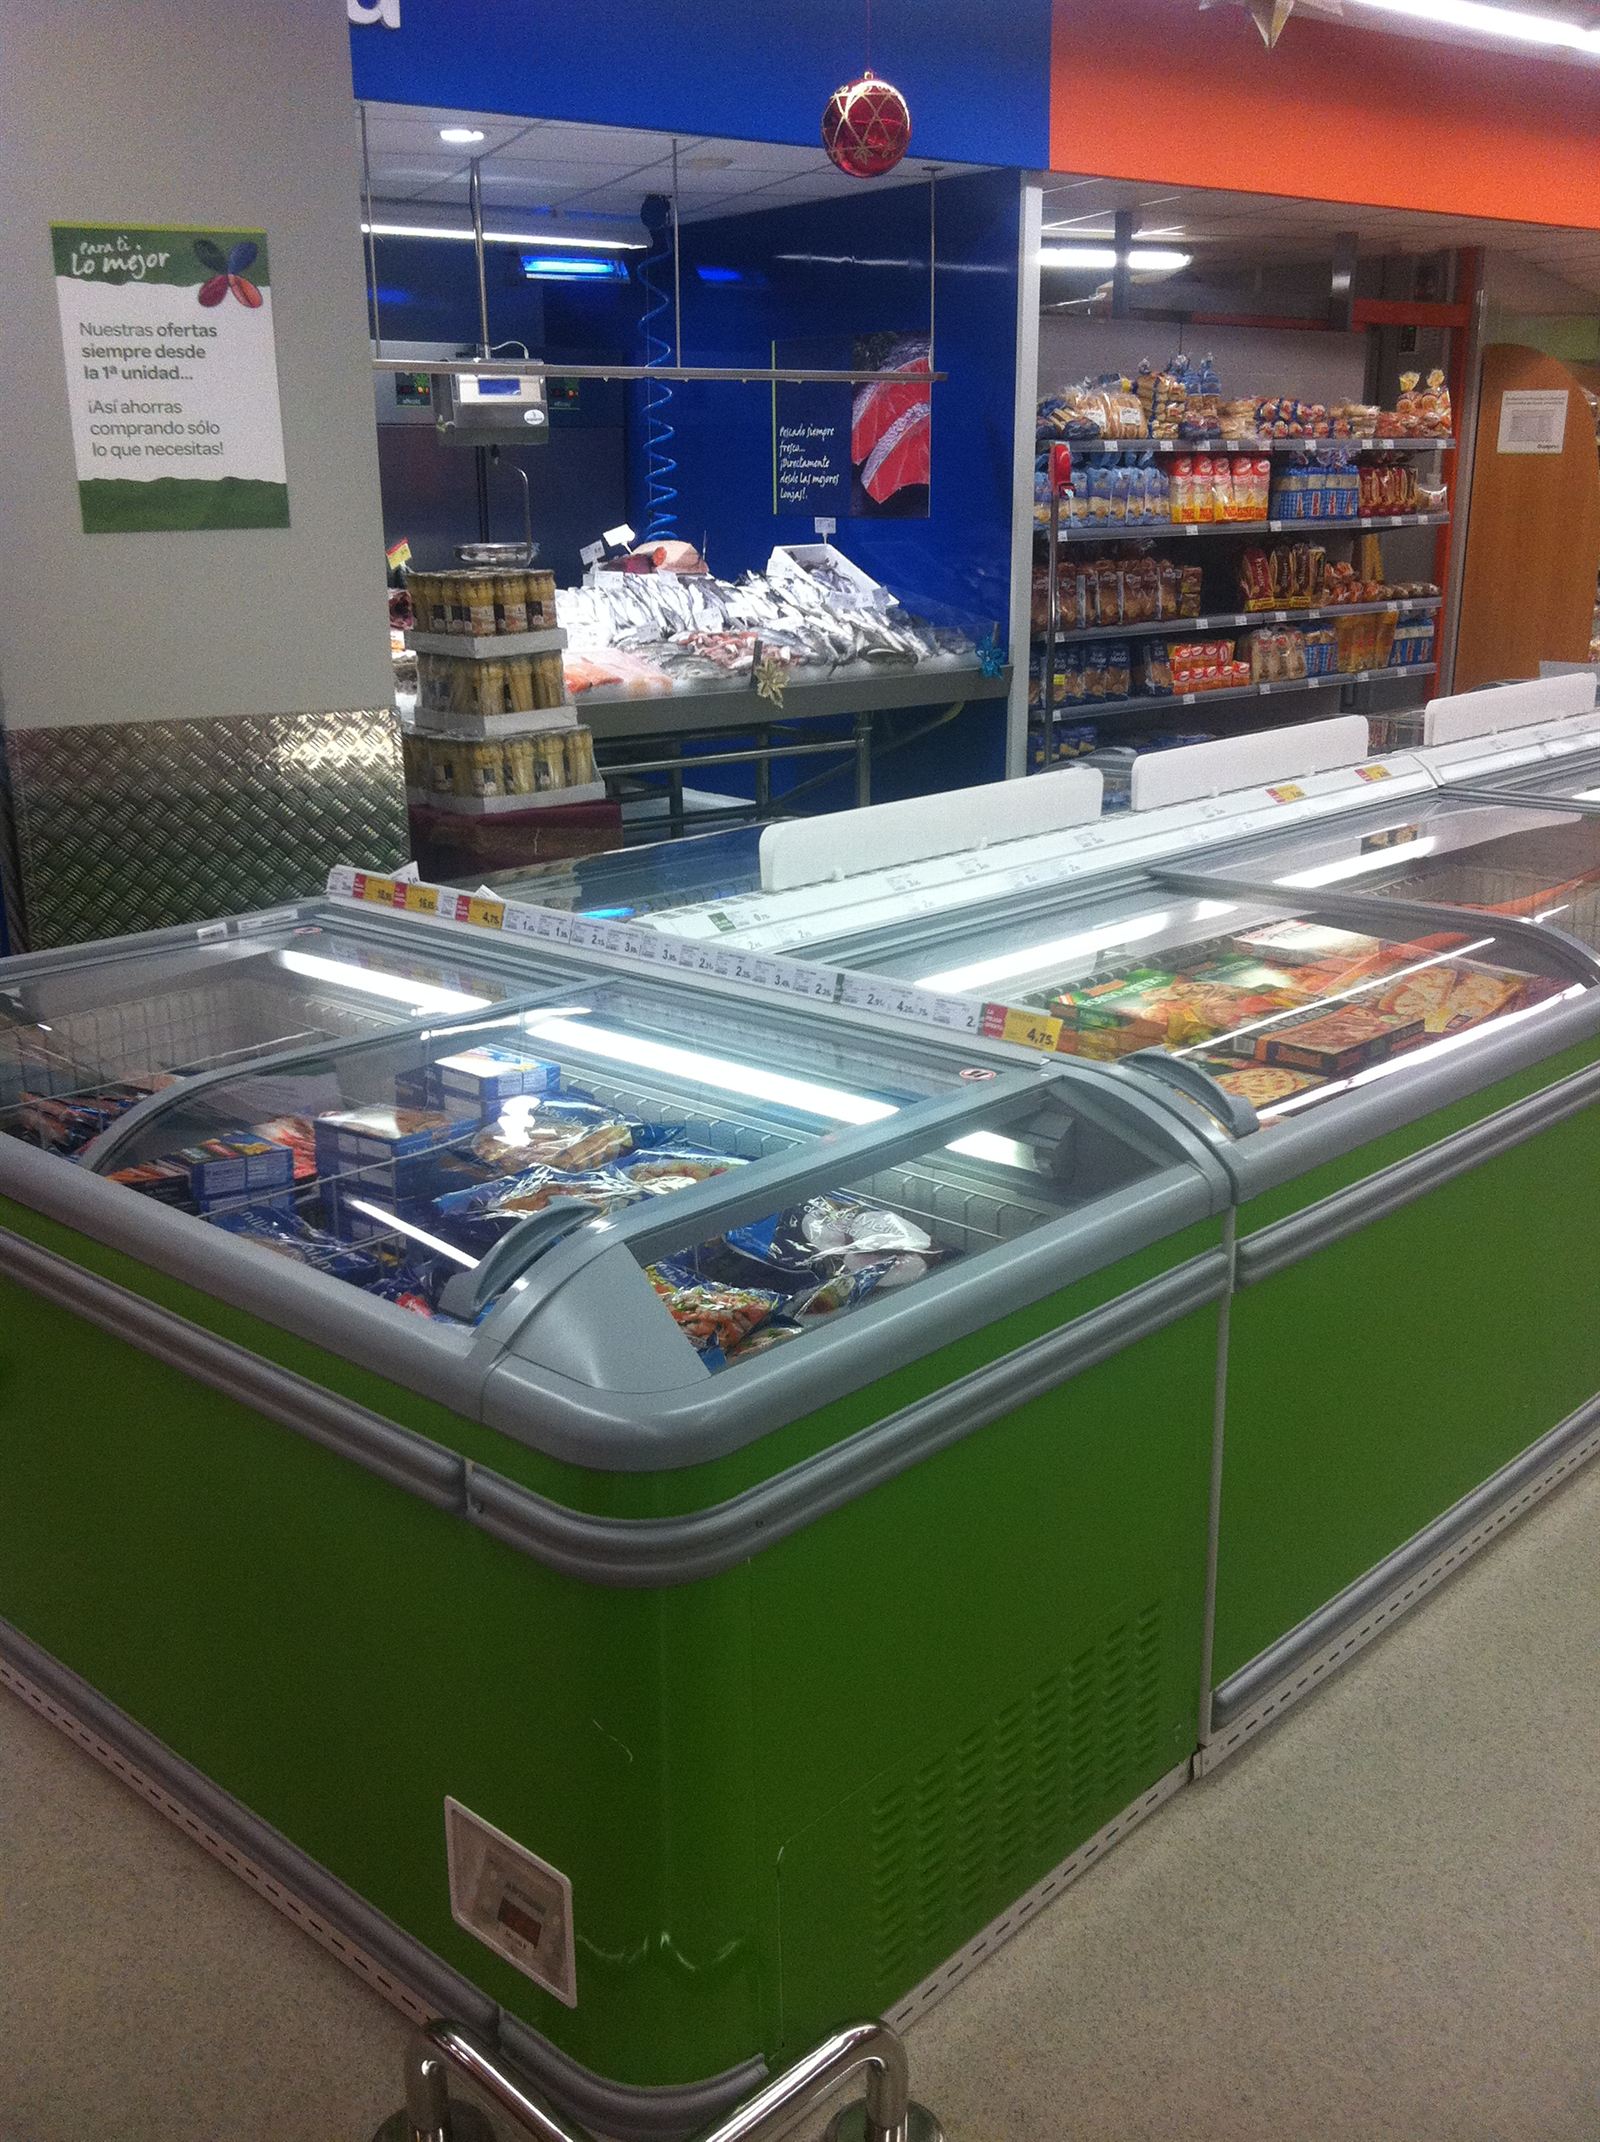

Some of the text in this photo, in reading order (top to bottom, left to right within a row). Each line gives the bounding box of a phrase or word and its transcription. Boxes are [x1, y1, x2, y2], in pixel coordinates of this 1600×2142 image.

[102, 252, 170, 280] mejor
[79, 322, 218, 338] Nuestras ofertas
[81, 343, 206, 361] siempre desde
[84, 365, 99, 380] la
[120, 400, 183, 414] ahorras
[90, 420, 220, 439] comprando sólo
[92, 441, 224, 459] lo que necesitas!
